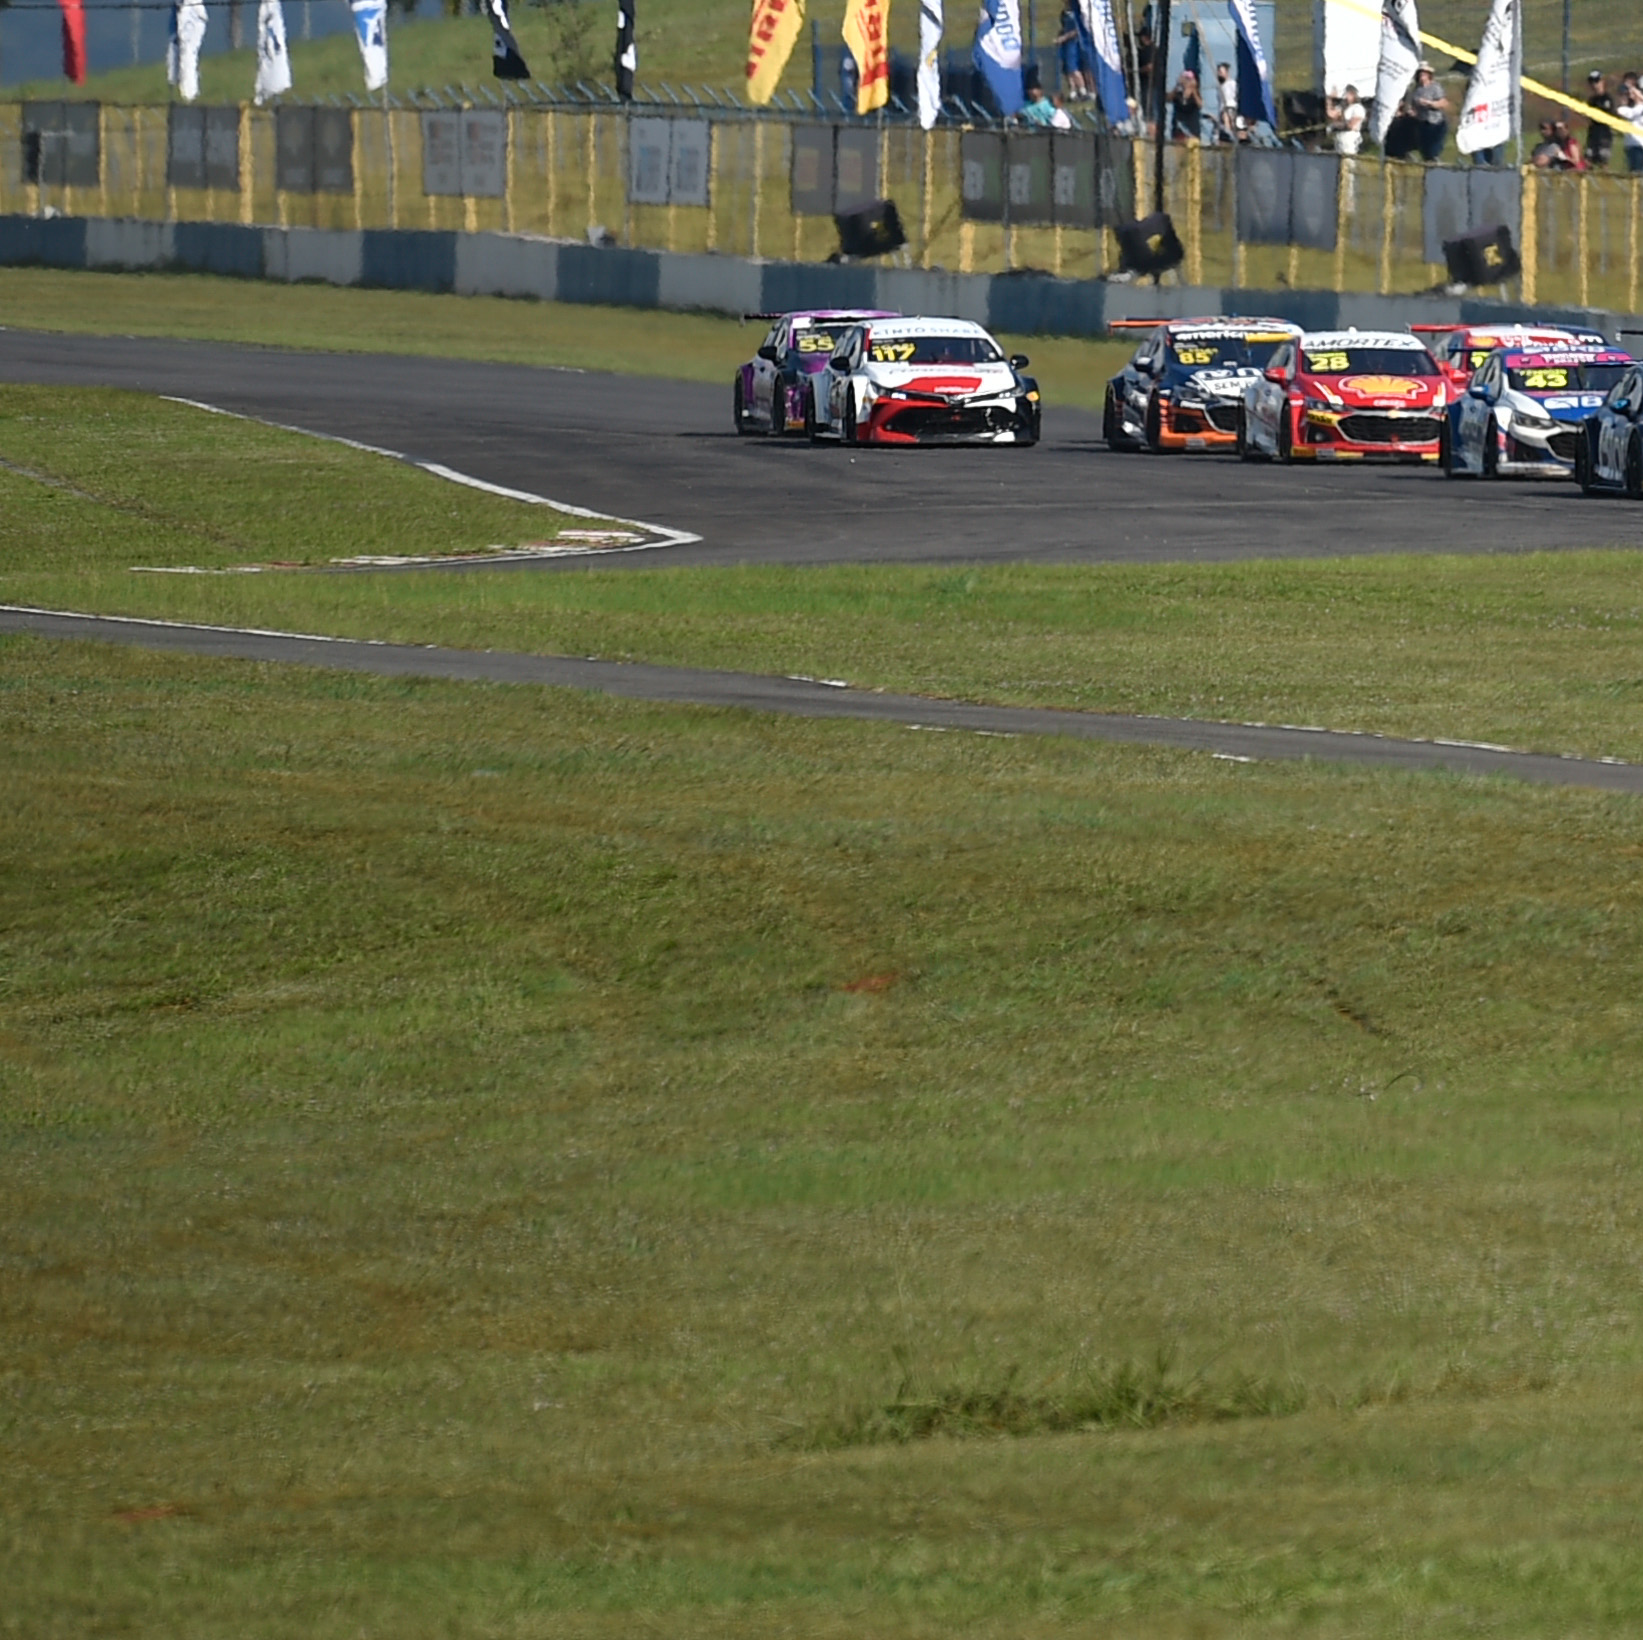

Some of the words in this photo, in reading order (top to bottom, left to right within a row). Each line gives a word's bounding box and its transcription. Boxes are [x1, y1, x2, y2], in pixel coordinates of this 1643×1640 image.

[798, 338, 834, 353] 55
[1304, 338, 1416, 348] AMORTEX
[872, 345, 916, 362] 117
[1179, 351, 1211, 365] 85
[1310, 356, 1350, 372] 28
[1525, 373, 1567, 388] 43
